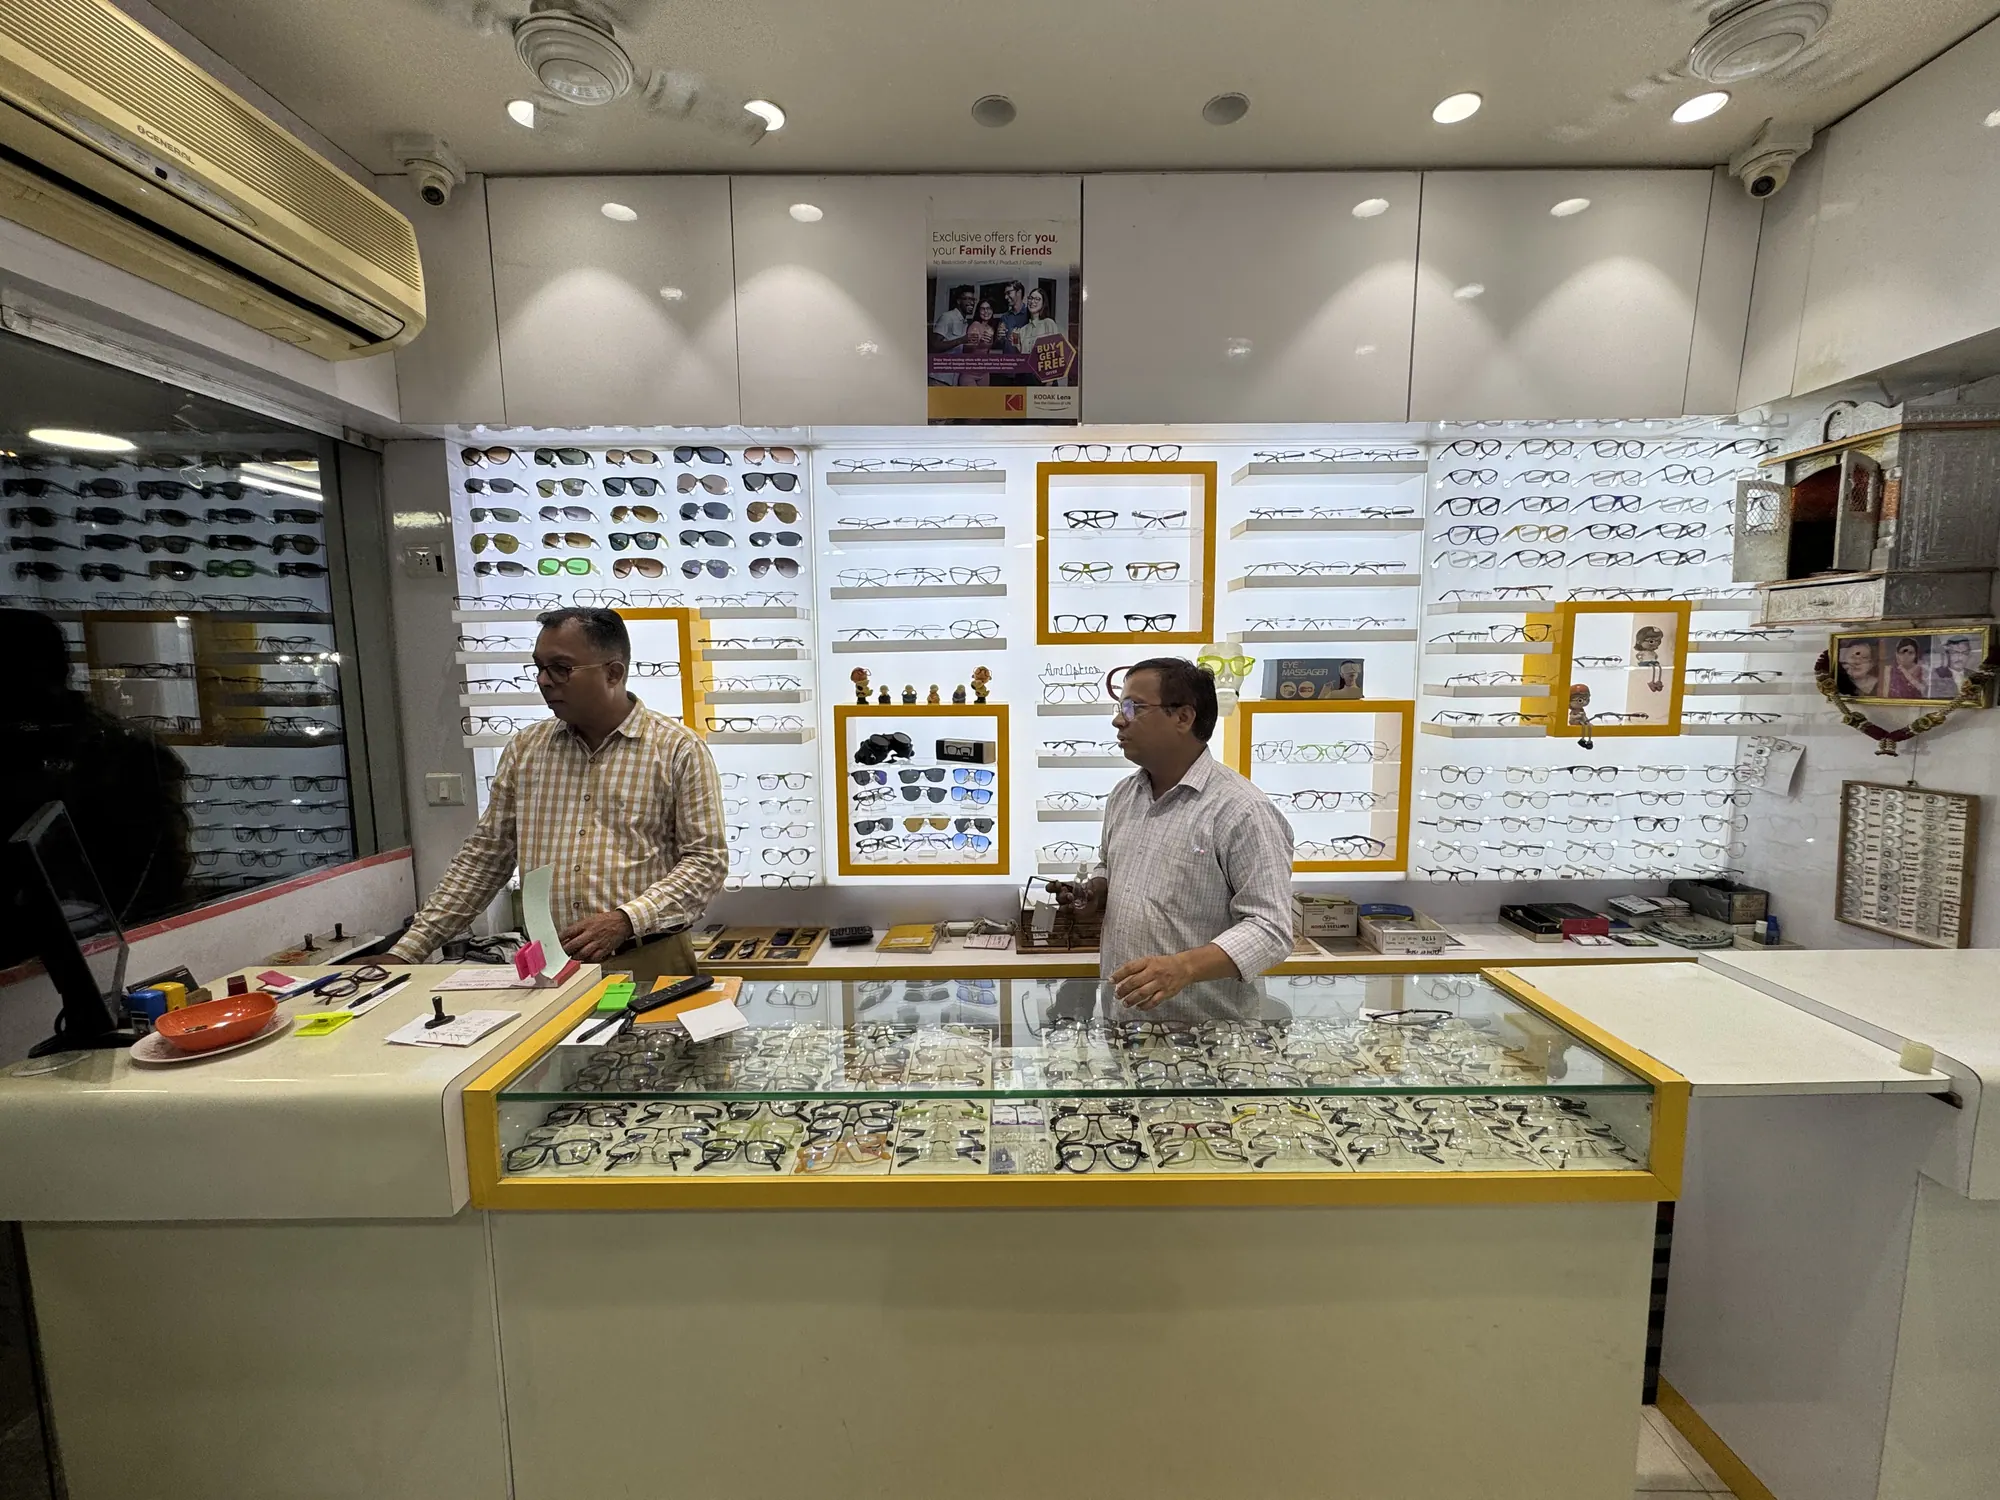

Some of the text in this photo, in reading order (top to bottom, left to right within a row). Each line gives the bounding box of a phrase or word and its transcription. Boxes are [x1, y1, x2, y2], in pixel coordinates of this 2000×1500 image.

[932, 230, 1058, 244] Exclusive offers for you,
[932, 244, 1052, 257] your Family & Friends
[1036, 340, 1065, 357] BUY 1
[1039, 350, 1057, 361] GET
[1037, 357, 1066, 372] FREE
[1033, 393, 1056, 401] KODAK
[1282, 661, 1299, 669] EYE
[1281, 668, 1329, 676] MASSAGER
